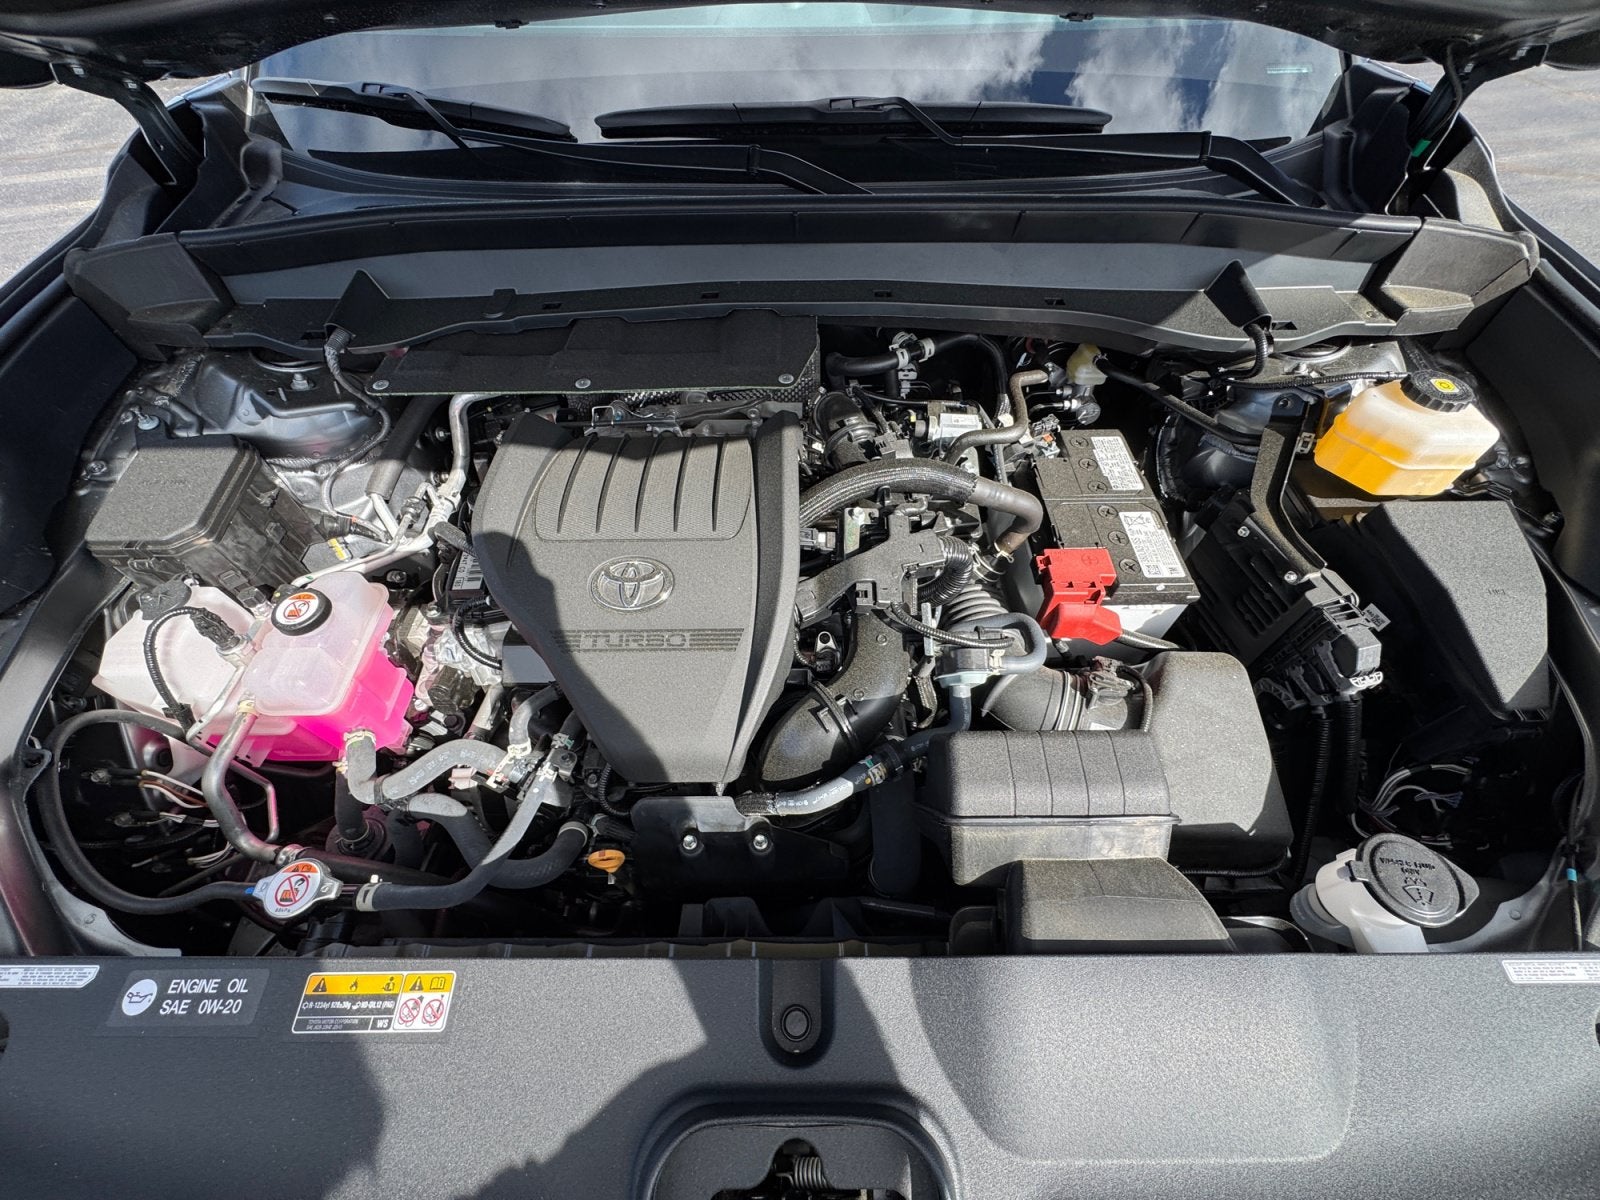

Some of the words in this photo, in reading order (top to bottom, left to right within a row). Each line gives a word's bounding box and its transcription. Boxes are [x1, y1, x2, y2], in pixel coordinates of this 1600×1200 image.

[583, 632, 687, 648] TURBO
[167, 979, 221, 994] ENGINE
[227, 978, 249, 994] OIL
[159, 999, 191, 1015] SAE
[198, 999, 242, 1015] 0W-20
[376, 1019, 389, 1029] WS
